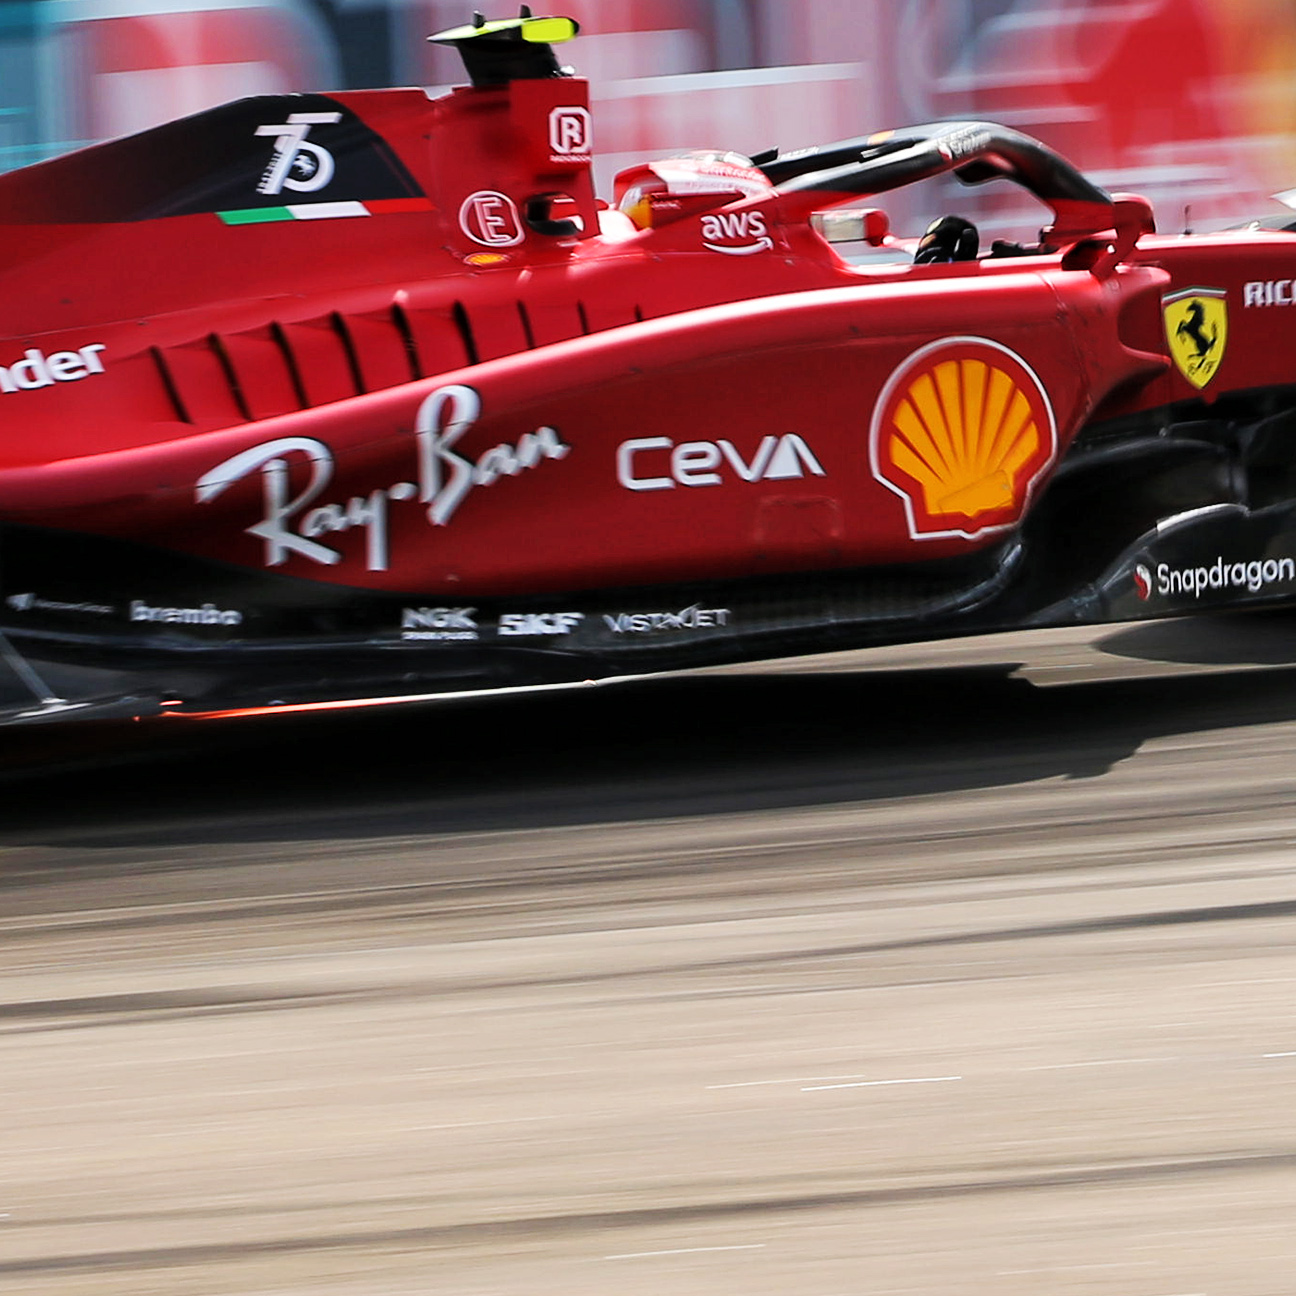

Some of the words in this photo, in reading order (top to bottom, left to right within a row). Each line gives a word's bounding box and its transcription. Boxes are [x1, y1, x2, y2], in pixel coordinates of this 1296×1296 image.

[701, 211, 768, 241] aws
[195, 382, 572, 572] Ray-Ban
[1157, 556, 1296, 599] Snapdragon
[130, 600, 244, 625] brembo
[402, 607, 479, 629] NGK
[497, 612, 585, 636] SKF
